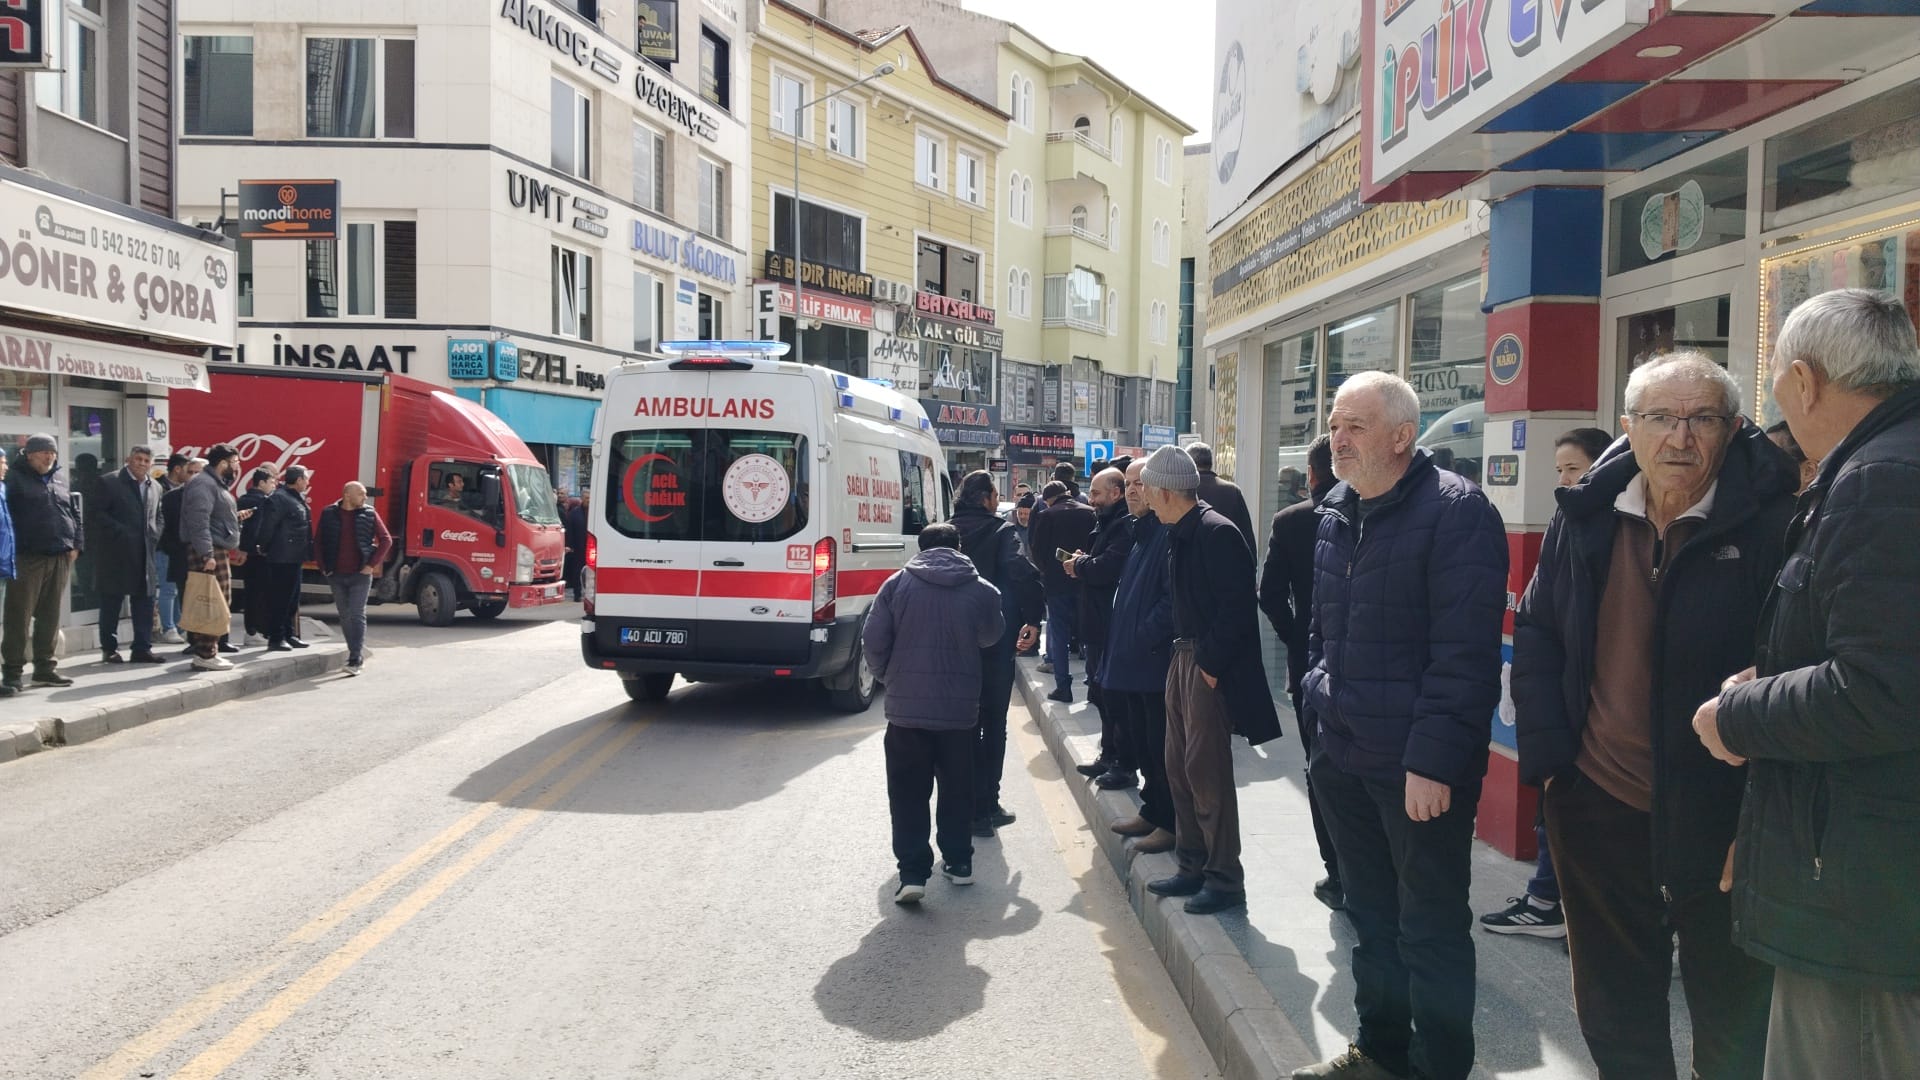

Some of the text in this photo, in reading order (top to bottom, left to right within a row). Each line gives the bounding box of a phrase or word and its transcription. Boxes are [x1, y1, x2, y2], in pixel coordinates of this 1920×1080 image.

[501, 0, 590, 66] AKKOÇ
[635, 65, 697, 136] ÖZGENÇ
[507, 169, 571, 223] UMT
[244, 205, 332, 220] mondihome
[1301, 221, 1316, 239] Yelek
[1320, 199, 1352, 228] Yağmurluk
[91, 226, 98, 249] 0
[102, 230, 123, 255] 542
[128, 236, 148, 262] 522
[151, 244, 164, 266] 67
[167, 249, 181, 271] 04
[633, 220, 737, 285] BULUT SİGORTA
[784, 257, 873, 296] BDİR İNŞAAT
[106, 263, 125, 304] &
[134, 271, 217, 324] ÇORBA
[824, 303, 861, 324] EMLAK
[917, 292, 976, 321] BAYSAL
[924, 323, 944, 340] AK
[954, 326, 980, 346] GÜL
[57, 353, 95, 375] DÖNER
[109, 363, 143, 382] ÇORBA
[451, 354, 483, 362] HARCA
[451, 361, 483, 369] HARCA
[518, 347, 574, 386] EZEL
[634, 396, 775, 420] AMBULANS
[937, 404, 990, 427] ANKA
[1009, 432, 1074, 449] GÜL İLETİŞİM
[1091, 443, 1107, 462] P
[651, 472, 679, 489] ACİL
[847, 472, 869, 496] SAĞLIK
[644, 490, 686, 507] SAĞLIK
[790, 546, 809, 560] 112
[627, 630, 684, 645] 40 ACU 780
